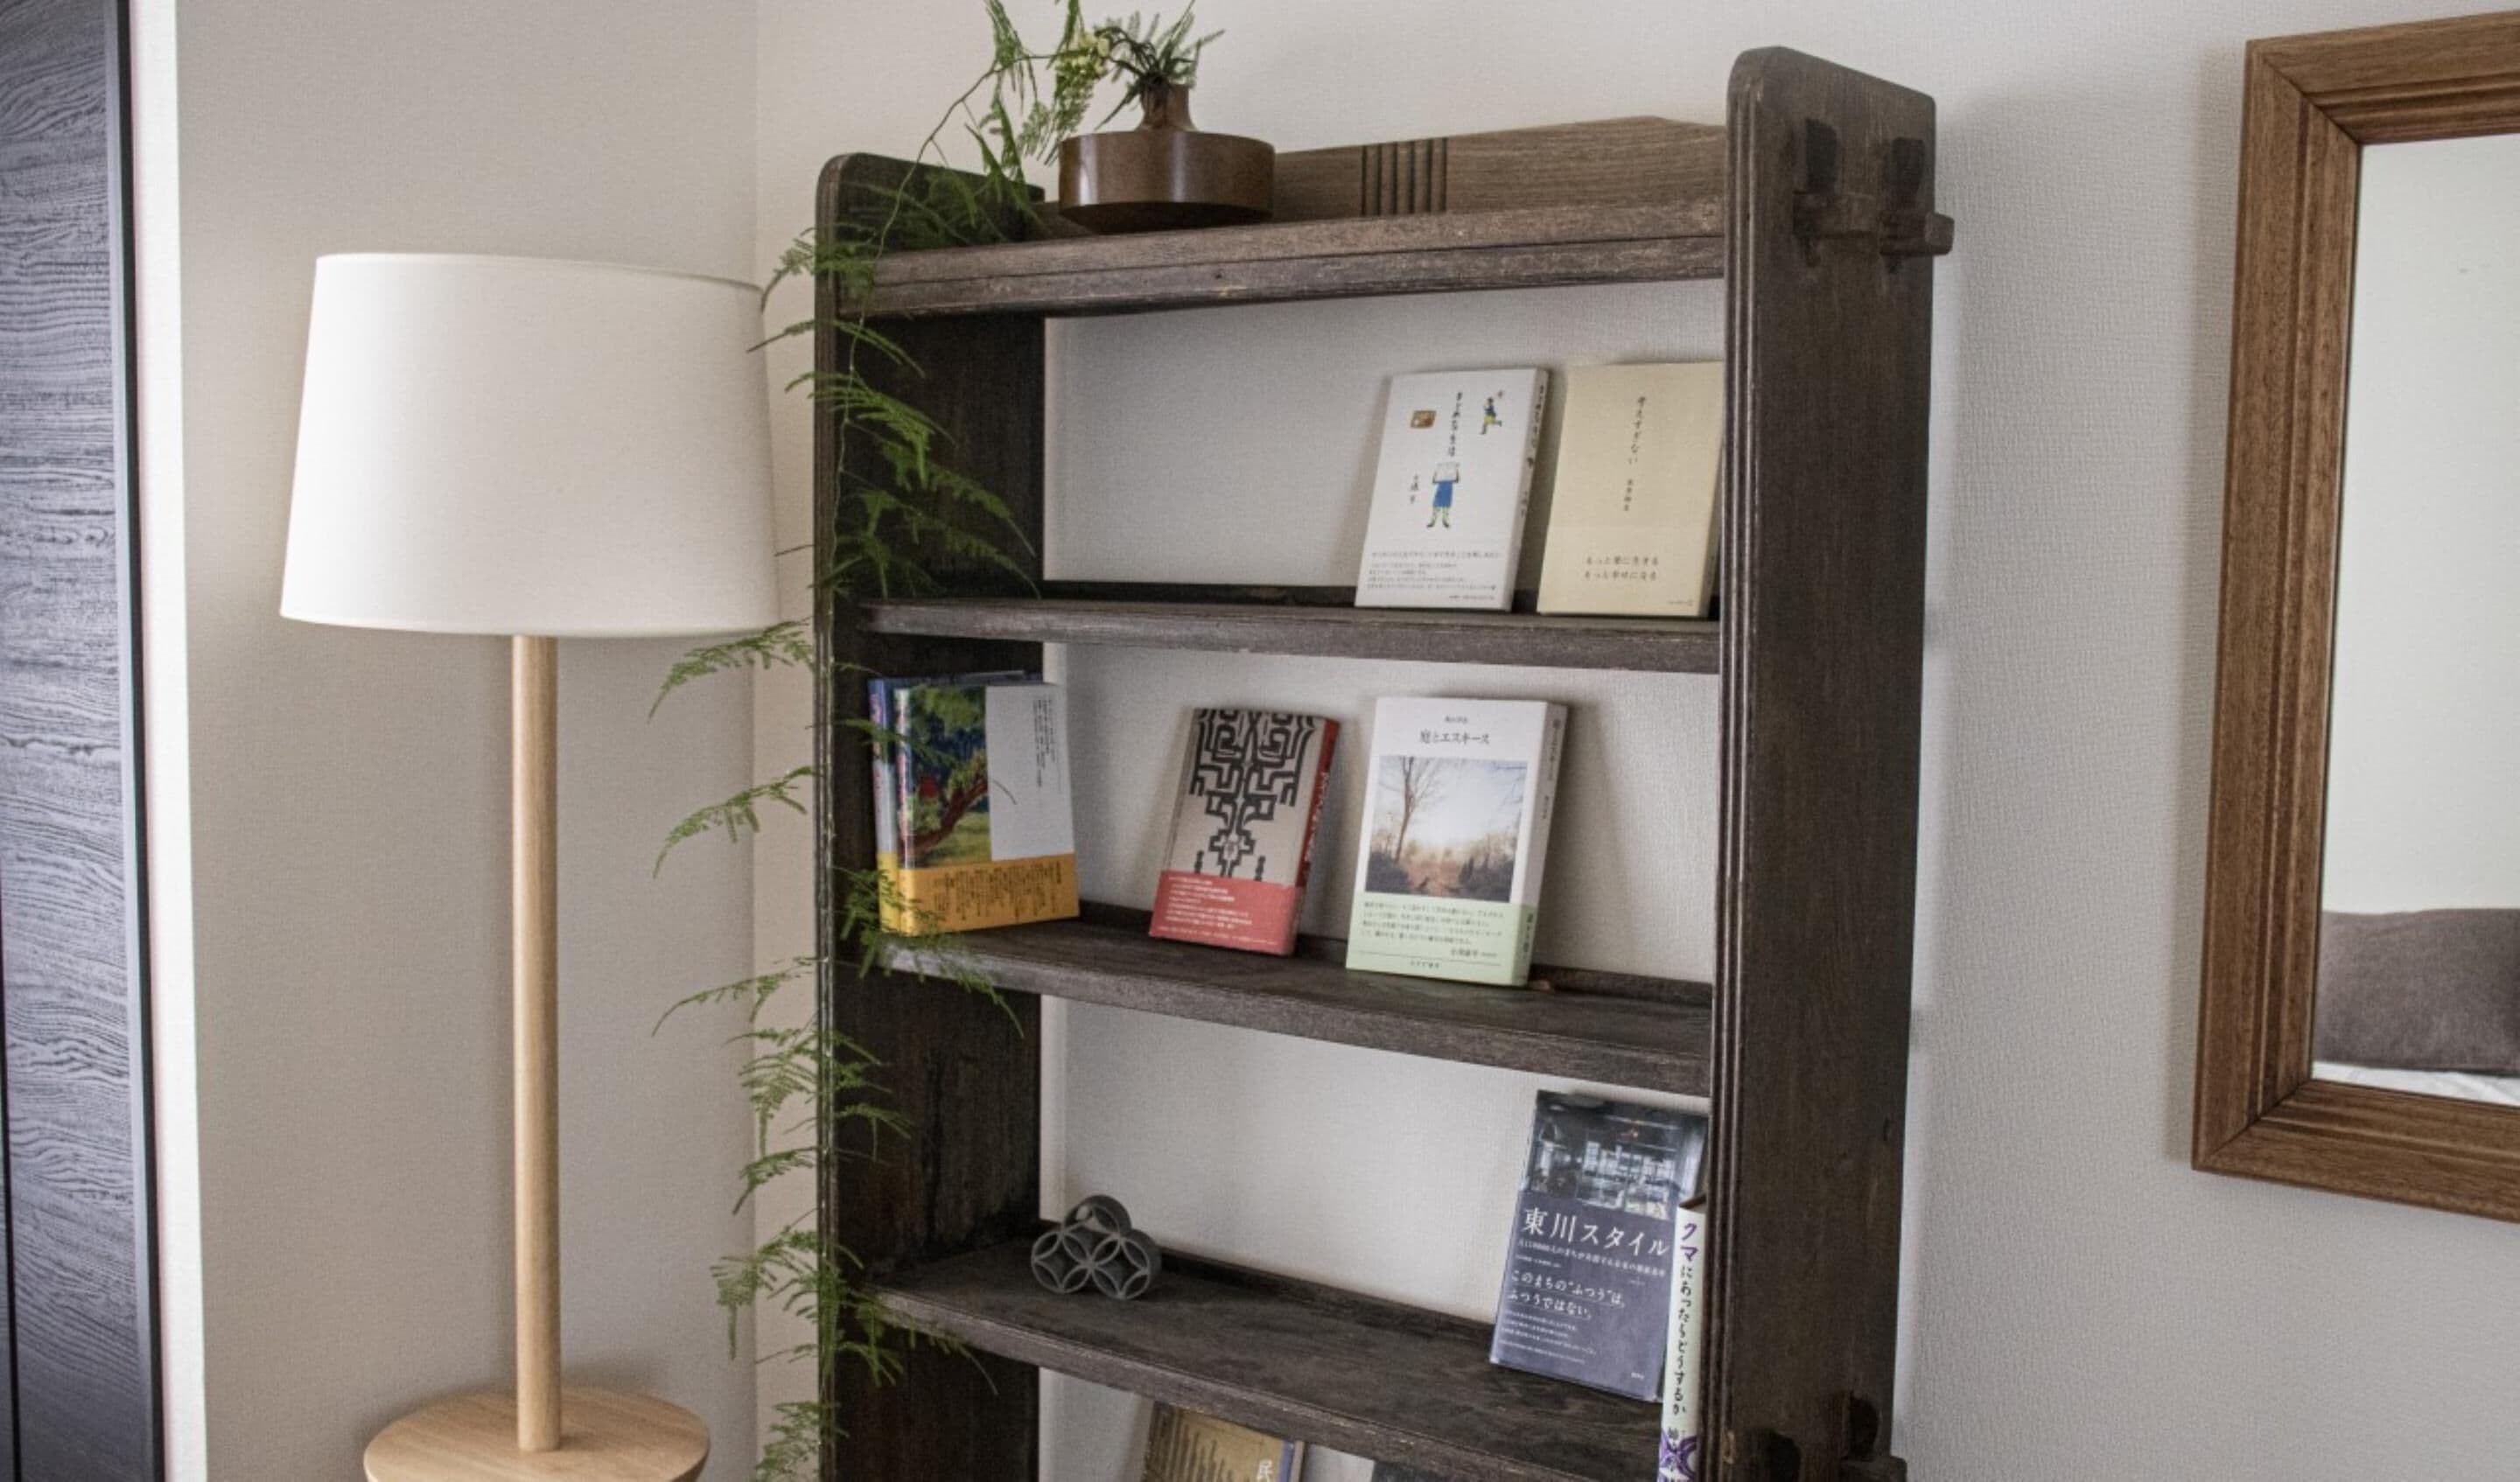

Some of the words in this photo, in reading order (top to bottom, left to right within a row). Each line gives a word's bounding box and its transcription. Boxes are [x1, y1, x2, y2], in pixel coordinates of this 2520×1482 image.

[1628, 395, 1647, 465] 考えすぎない
[1419, 730, 1490, 744] 庭とエスキース
[1521, 1206, 1670, 1257] 東川スタイル
[1672, 1222, 1698, 1416] クマにあったらどうするか
